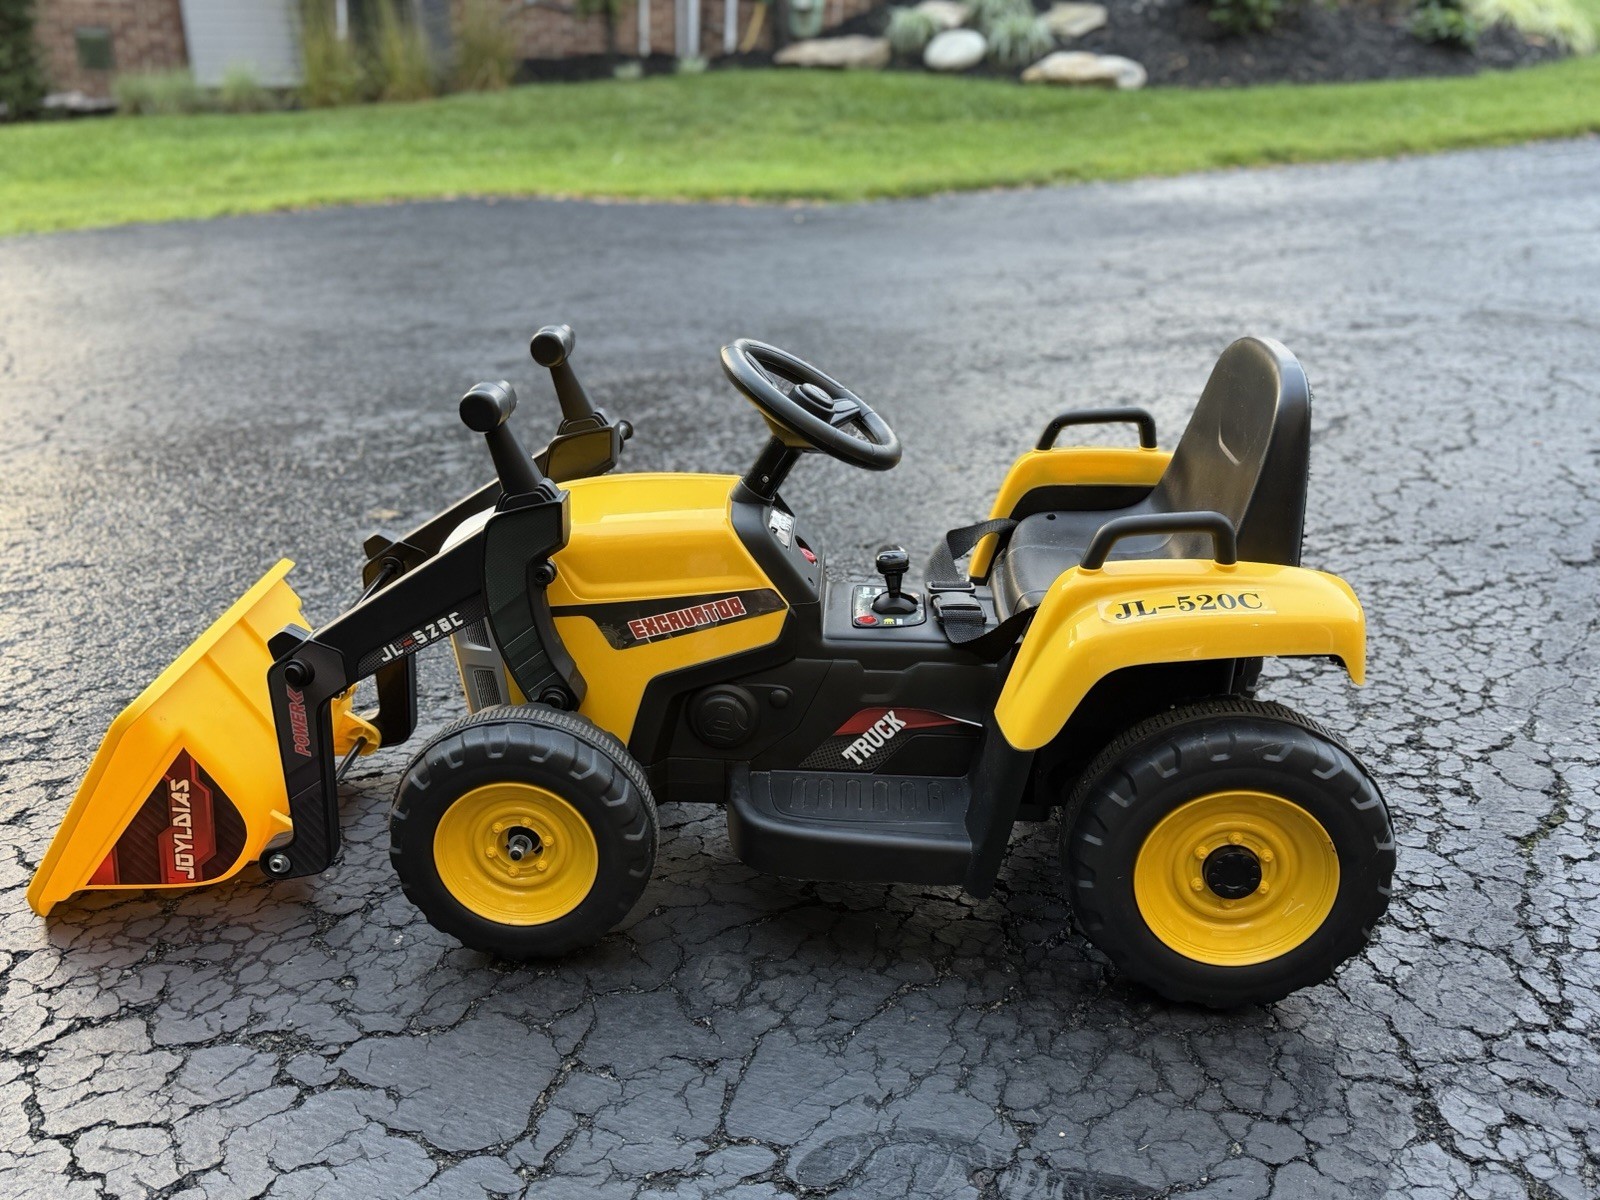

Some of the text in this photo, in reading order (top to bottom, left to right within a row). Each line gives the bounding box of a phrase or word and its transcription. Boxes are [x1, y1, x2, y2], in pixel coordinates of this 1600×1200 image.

[627, 596, 747, 640] EXCAVATOR
[1115, 592, 1263, 620] JL-520C
[841, 709, 907, 766] TRUCK
[169, 778, 196, 879] JOYLDIAS
